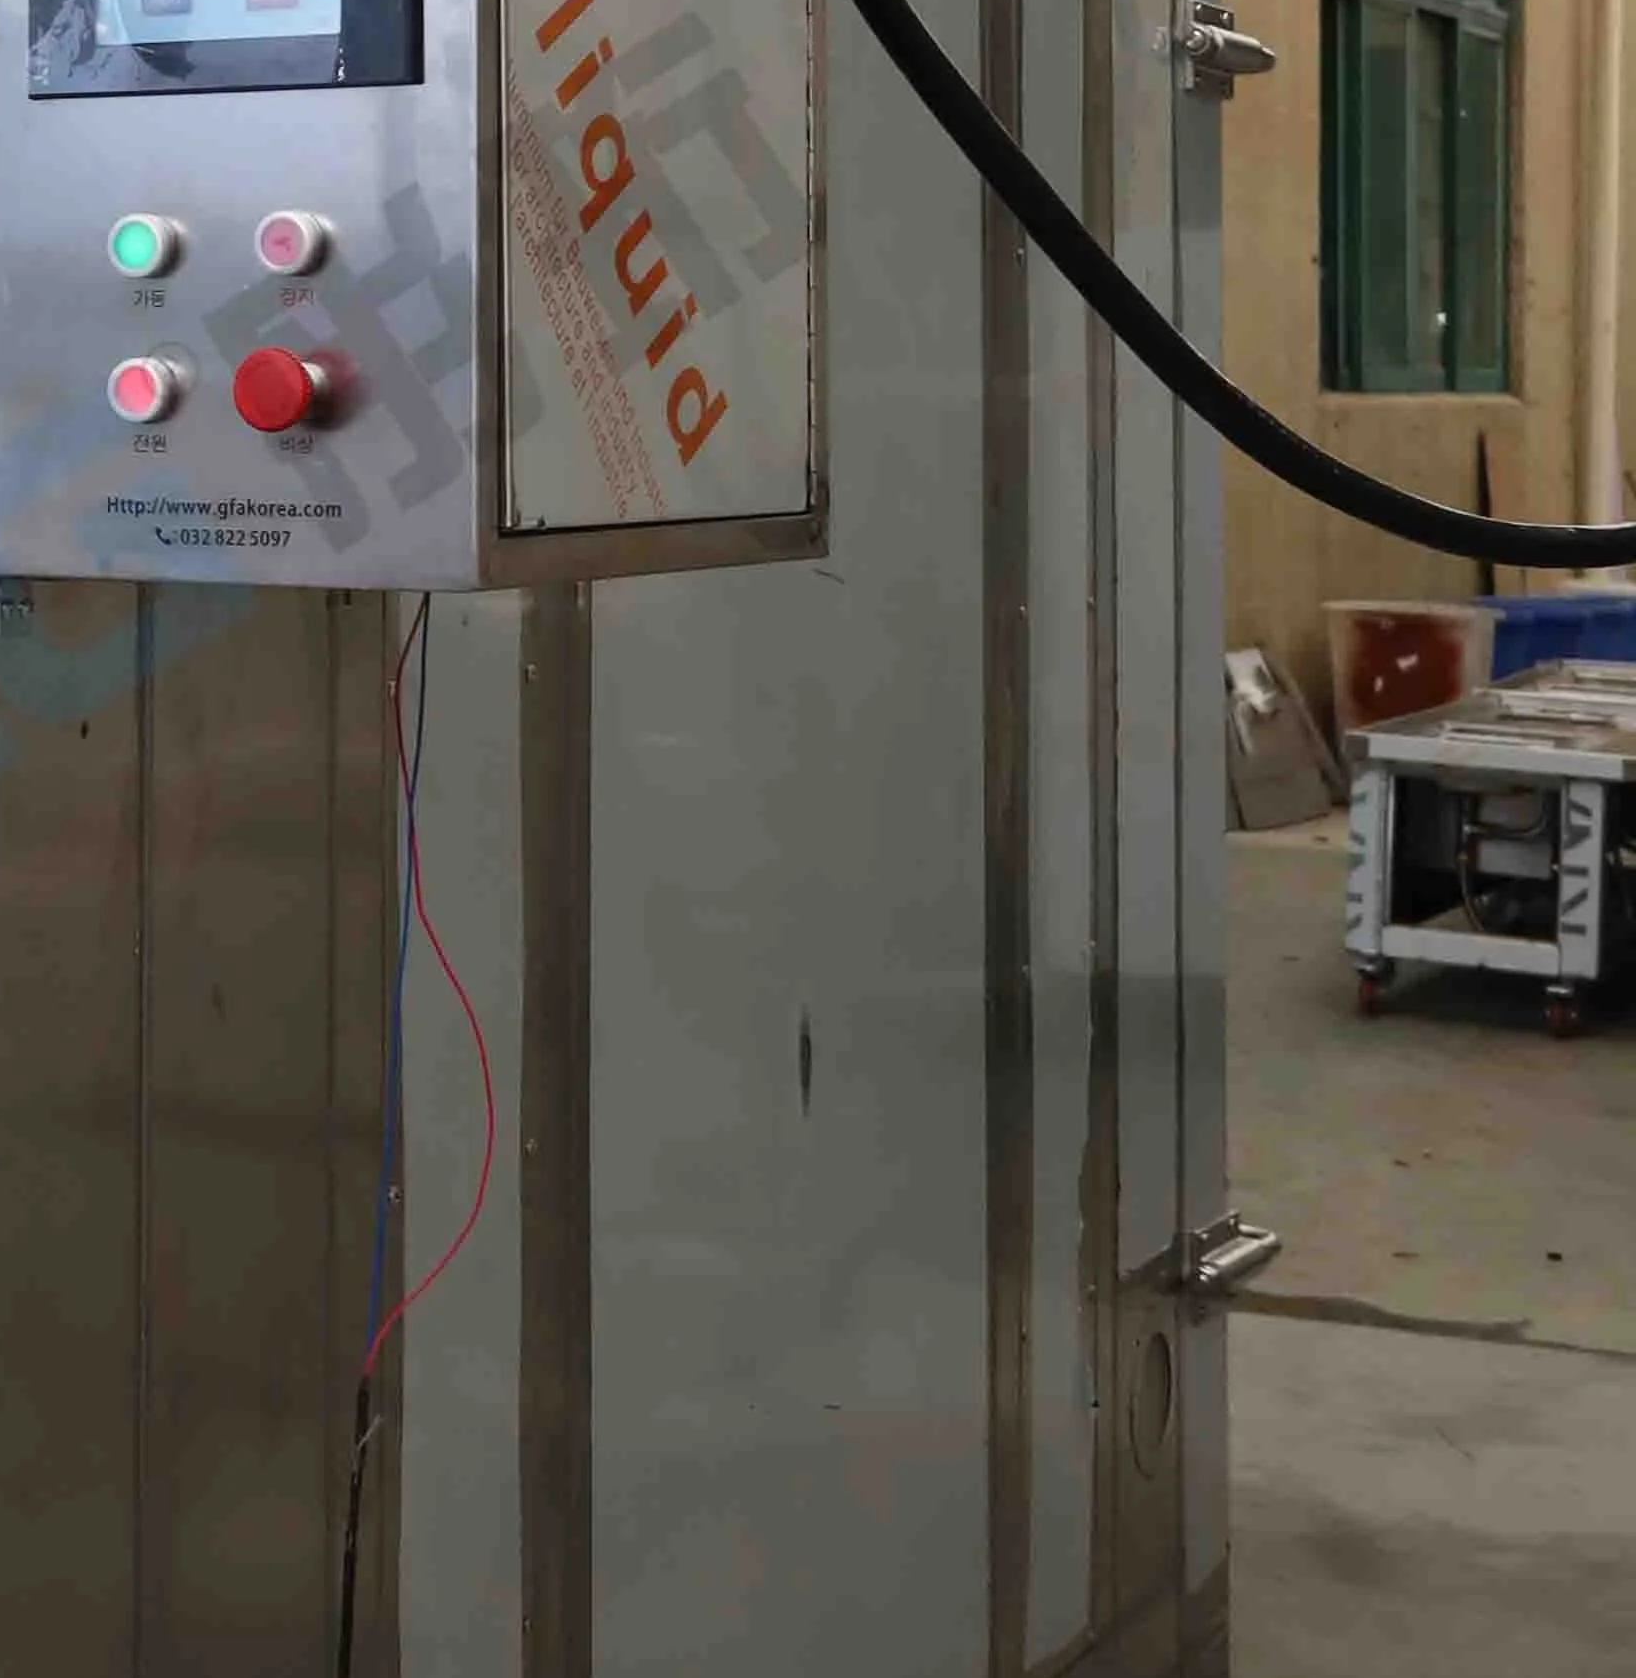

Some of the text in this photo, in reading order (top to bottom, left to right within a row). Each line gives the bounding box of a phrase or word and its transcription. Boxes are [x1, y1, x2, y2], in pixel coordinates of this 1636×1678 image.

[107, 496, 342, 520] Http://www.gfakorea.com
[215, 528, 245, 547] 822
[249, 529, 292, 547] 5097
